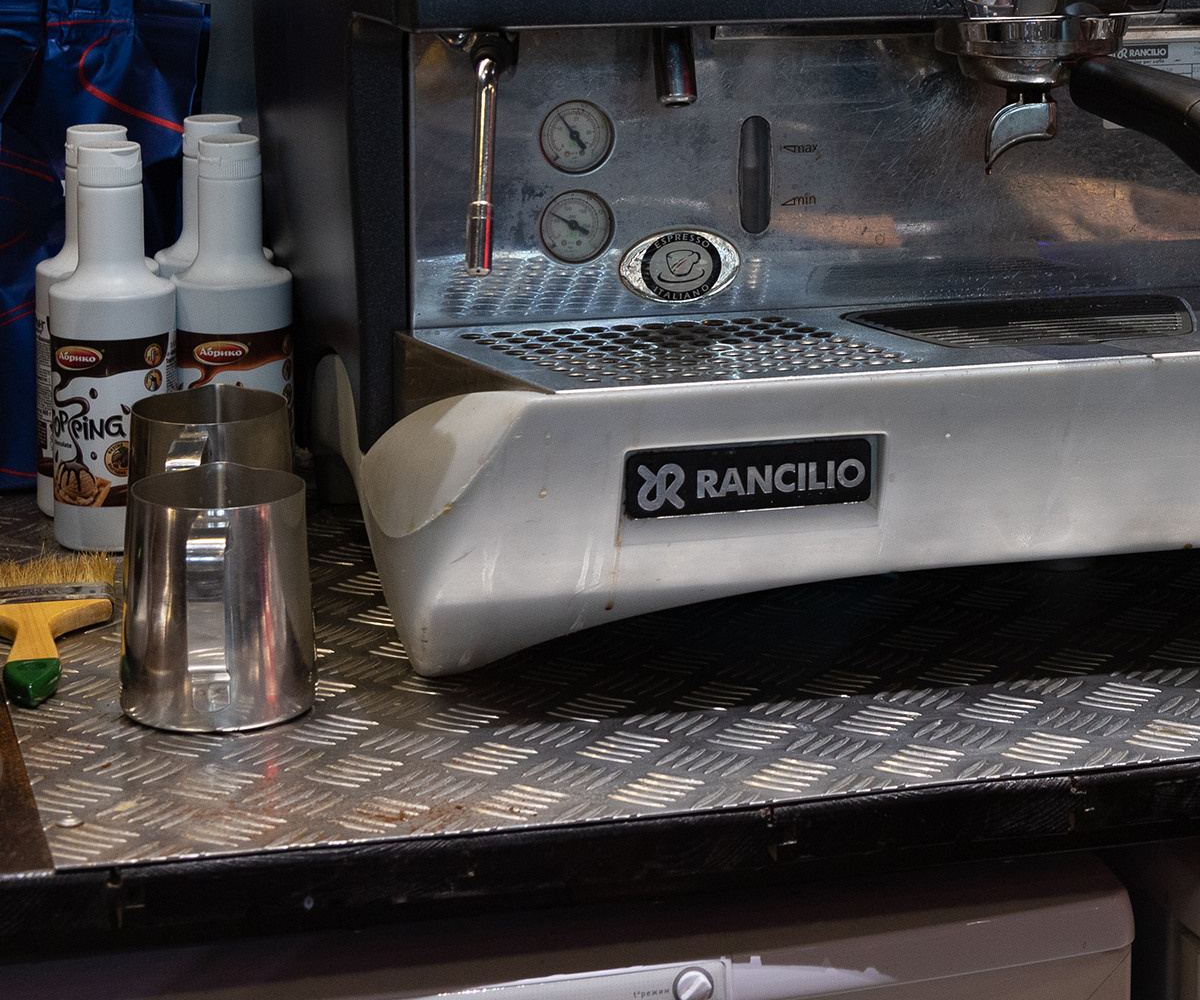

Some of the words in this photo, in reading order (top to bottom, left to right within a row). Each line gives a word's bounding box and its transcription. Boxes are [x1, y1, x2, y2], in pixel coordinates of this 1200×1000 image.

[1129, 48, 1167, 58] RANCILIO
[795, 143, 819, 153] max
[795, 193, 816, 205] min
[654, 233, 710, 250] ESPRESSO
[653, 284, 710, 300] ITALIANO
[59, 351, 96, 363] Абрико
[199, 346, 242, 358] Абрико
[52, 409, 128, 440] OPPING
[696, 458, 866, 500] RANCILIO
